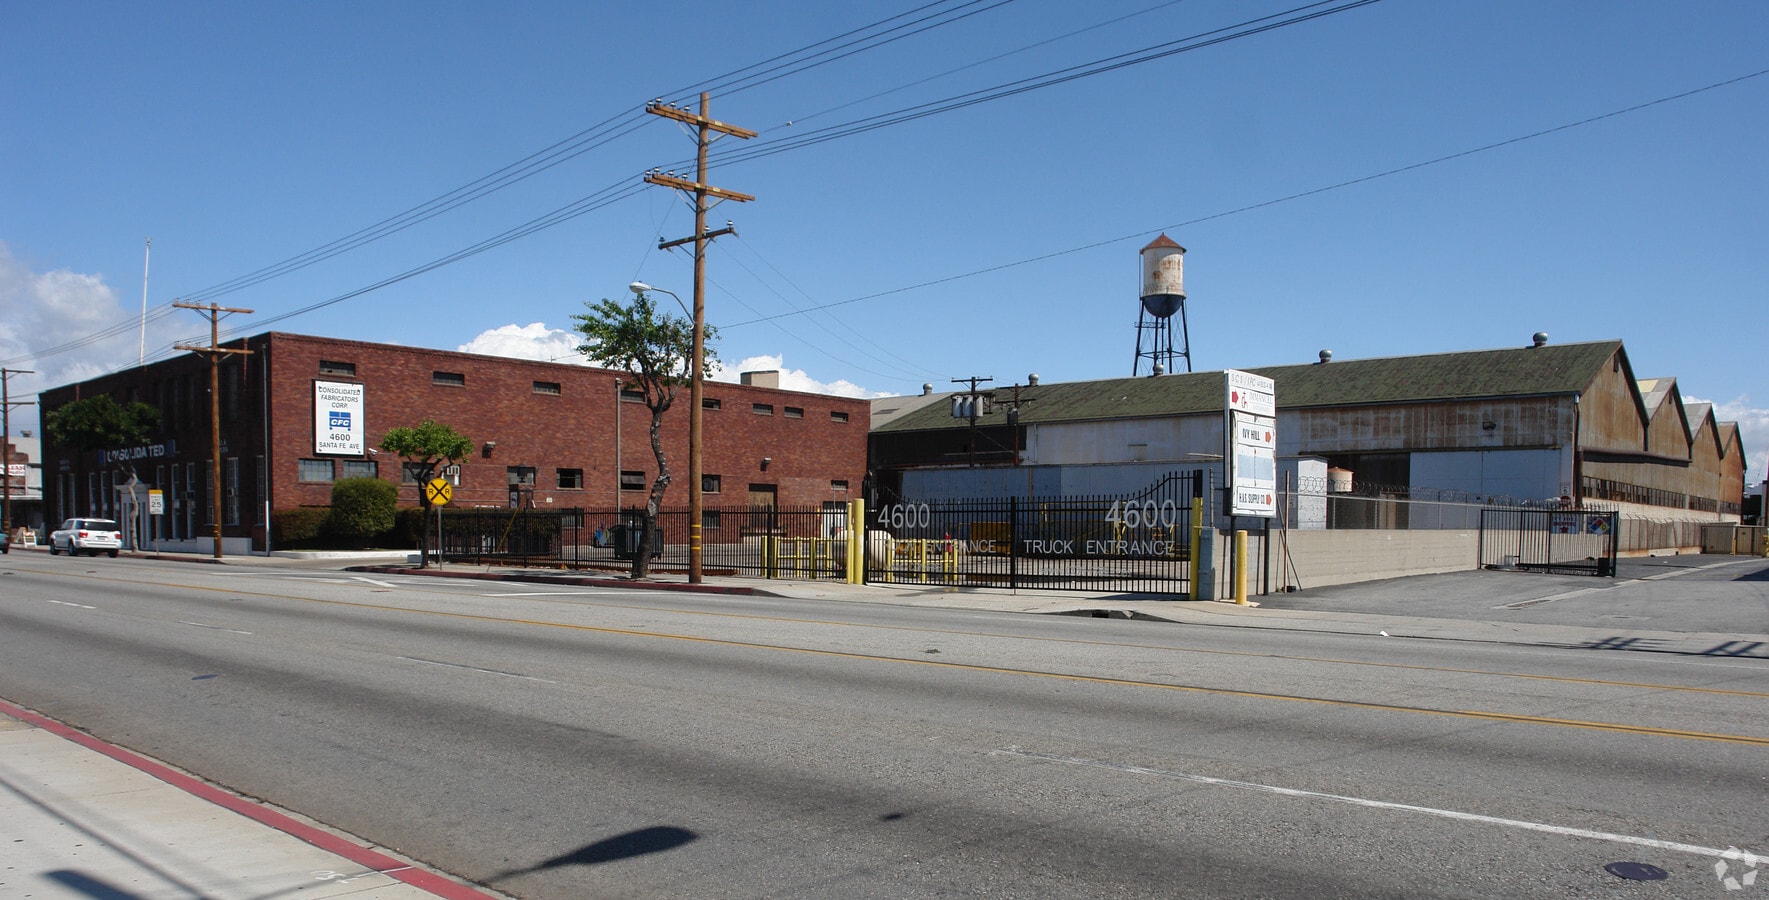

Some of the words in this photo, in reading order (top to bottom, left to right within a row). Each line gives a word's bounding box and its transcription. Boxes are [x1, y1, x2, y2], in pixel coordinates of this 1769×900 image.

[319, 387, 360, 395] CONSOLIDATED
[320, 395, 359, 403] FABRICATORS
[330, 419, 350, 427] CFC
[329, 433, 351, 442] 4600
[318, 441, 337, 449] SANTA
[877, 503, 930, 529] 4600
[1105, 499, 1177, 528] 4600
[1023, 539, 1074, 554] TRUCK
[1086, 540, 1176, 556] ENTRANCE
